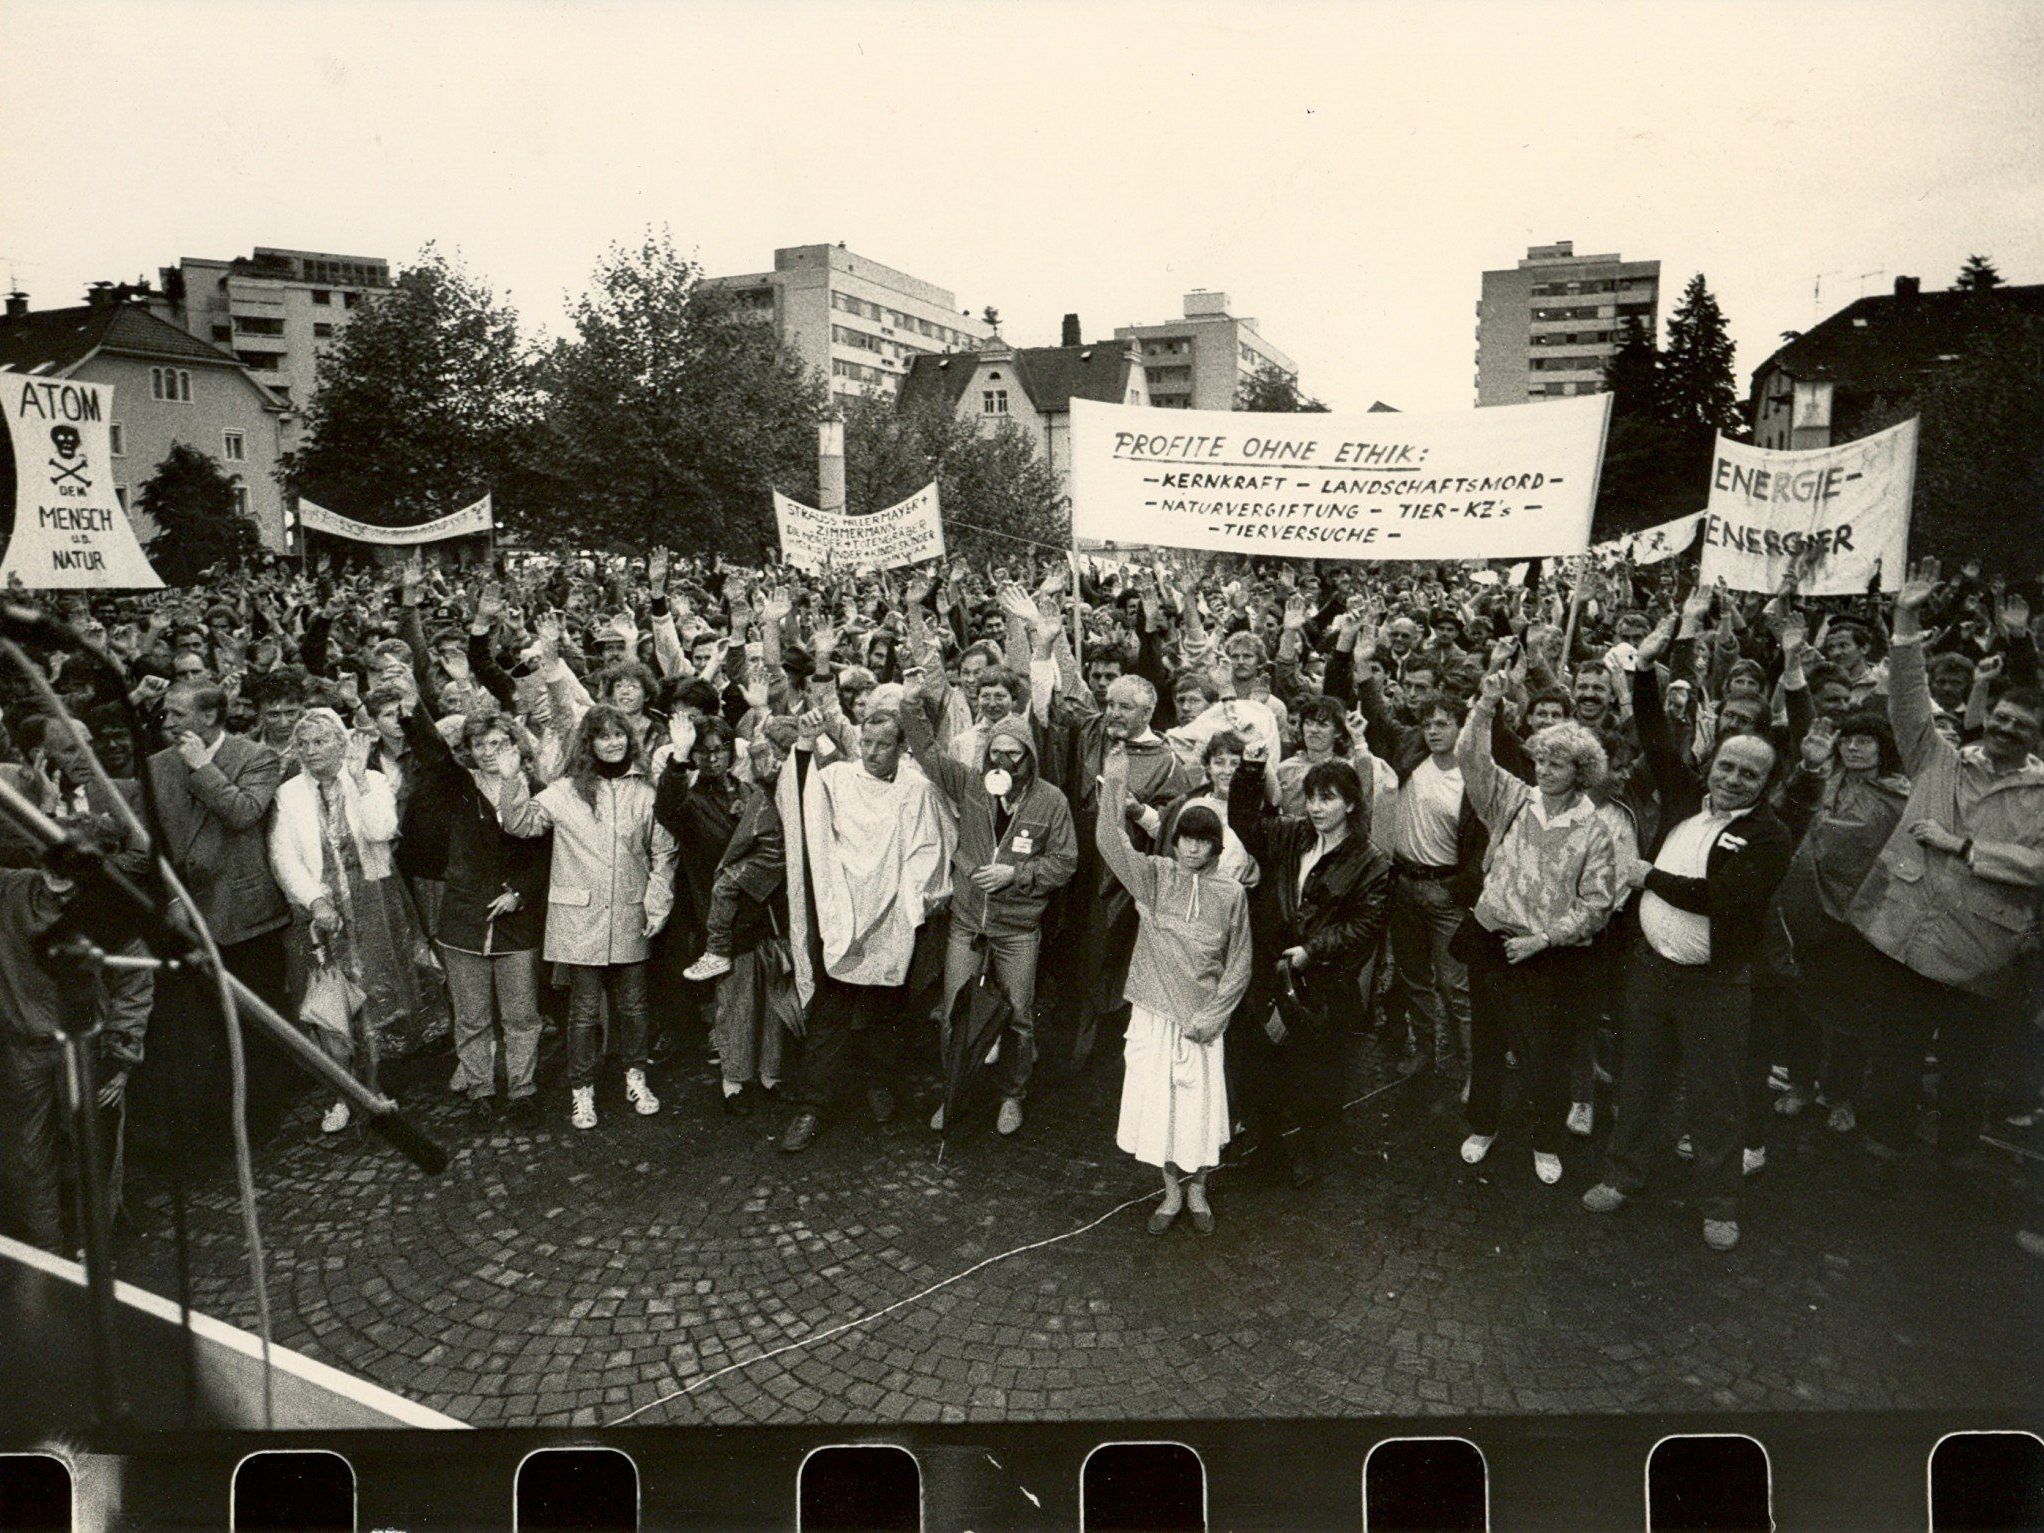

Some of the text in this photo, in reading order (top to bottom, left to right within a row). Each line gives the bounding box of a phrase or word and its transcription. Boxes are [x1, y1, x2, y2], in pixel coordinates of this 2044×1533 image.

[20, 381, 102, 422] ATOM
[1114, 432, 1429, 464] PROFITE OHNE ETHIK:
[59, 486, 87, 497] DEM
[39, 505, 113, 531] MENSCH
[787, 503, 837, 526] STRAUSS
[816, 523, 896, 540] ZIMMERMANN
[53, 551, 106, 571] NATUR
